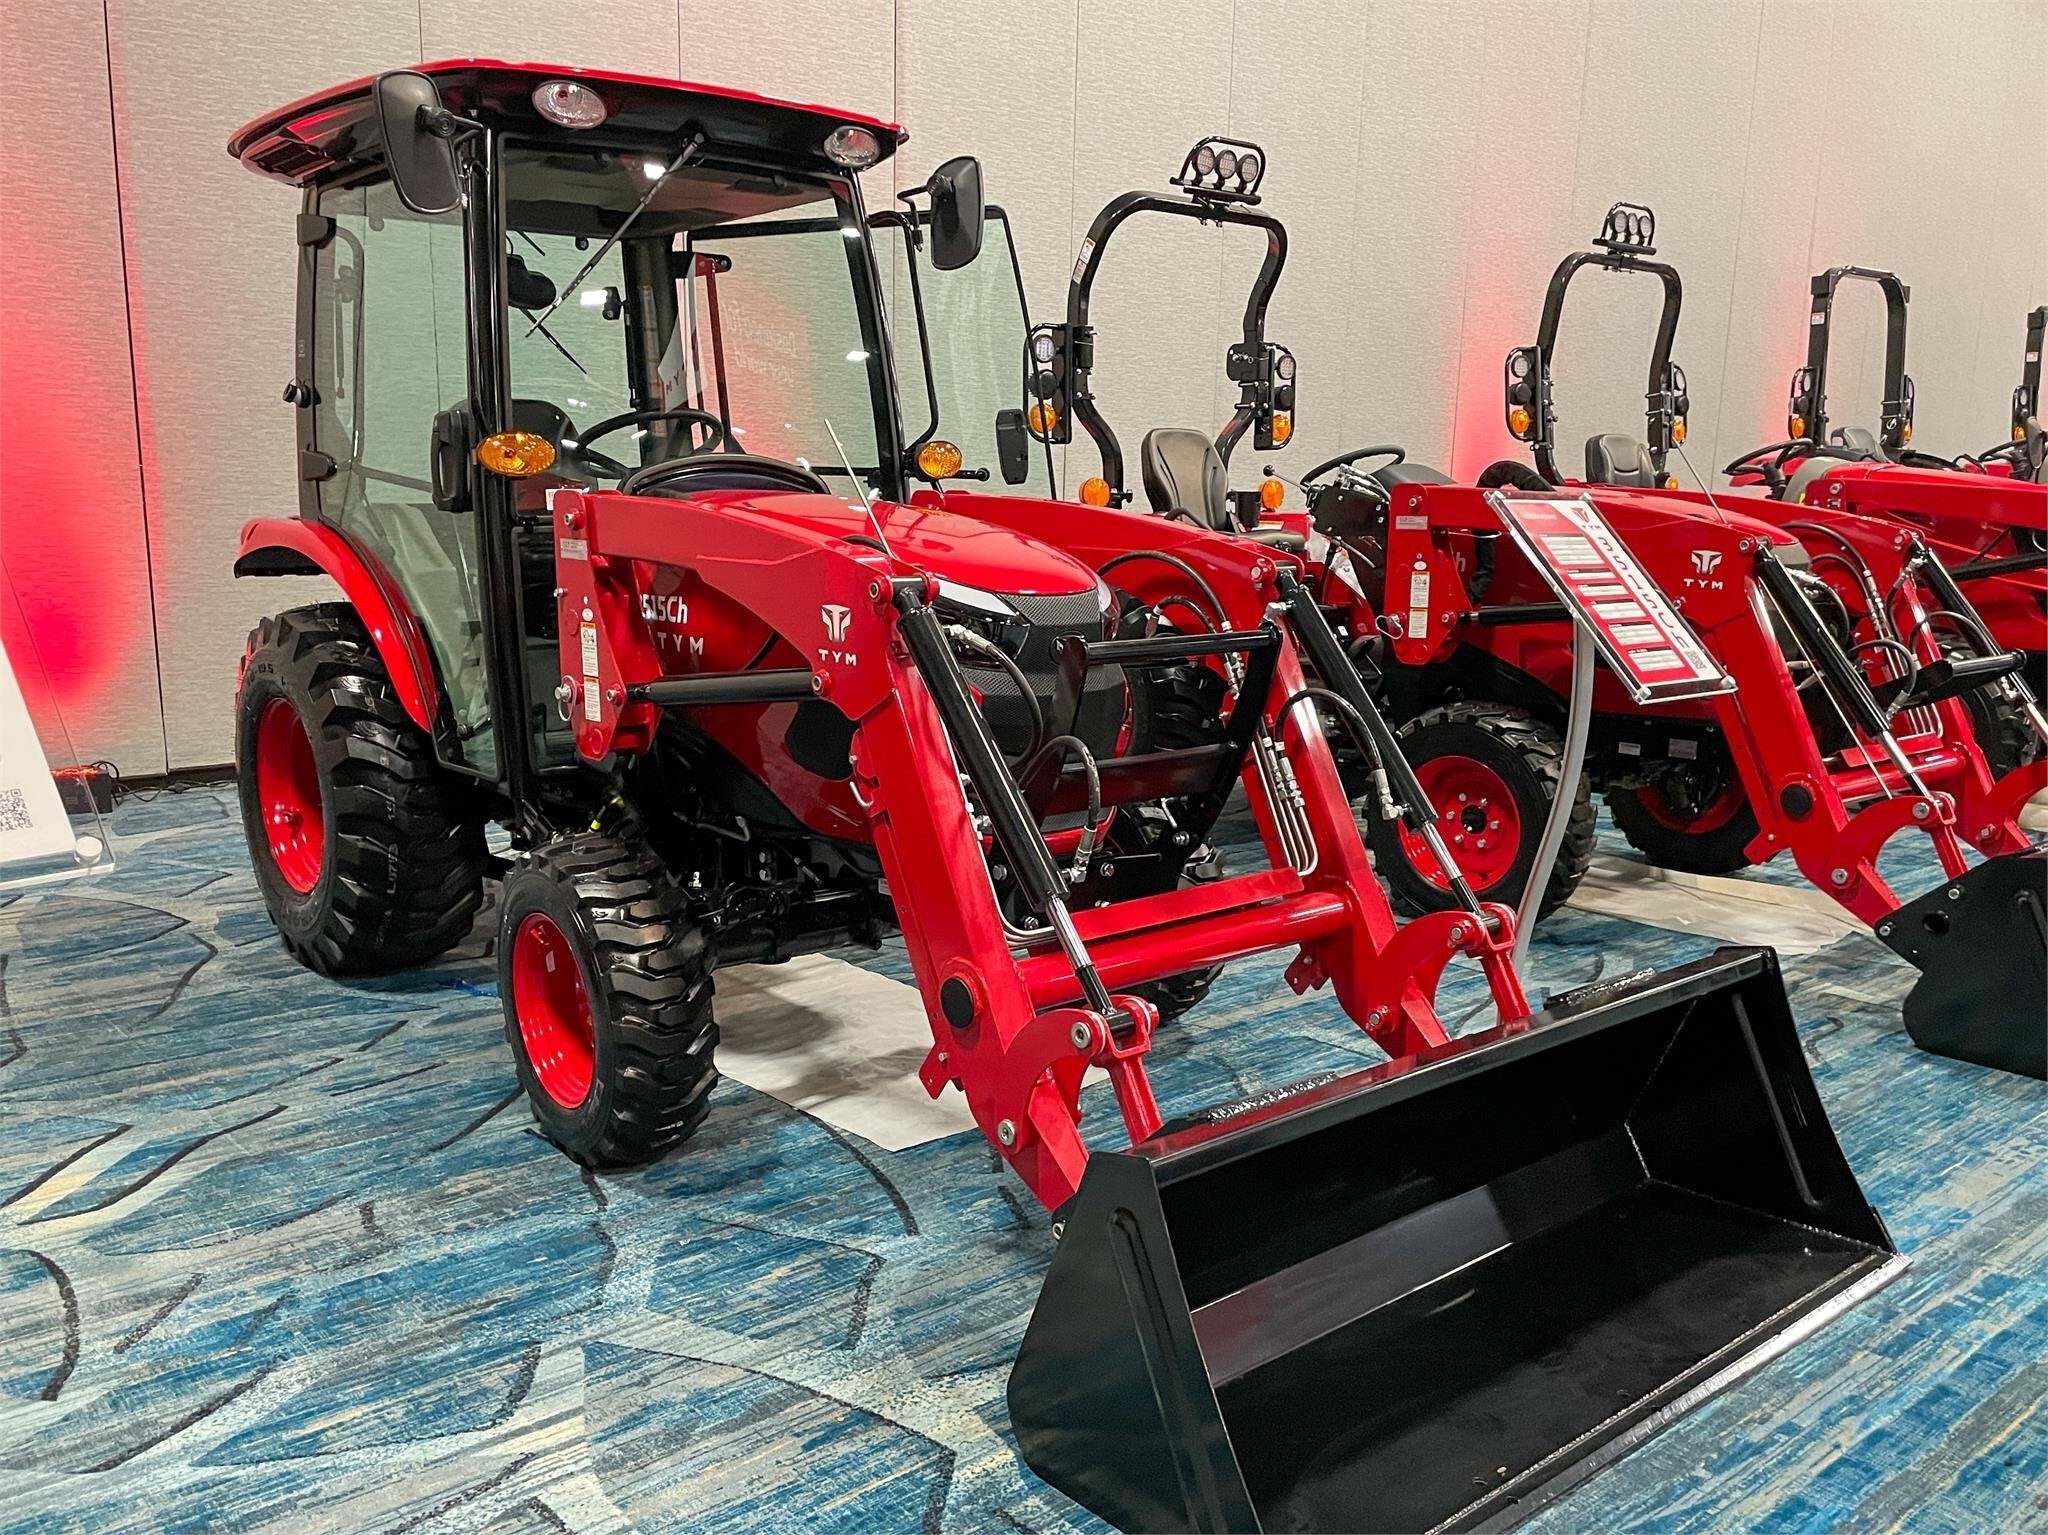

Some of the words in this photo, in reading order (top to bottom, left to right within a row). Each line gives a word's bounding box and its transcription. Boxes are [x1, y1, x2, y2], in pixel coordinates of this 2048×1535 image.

[1683, 578, 1724, 591] TYM
[639, 593, 689, 625] 515Ch
[656, 631, 704, 656] TYM
[818, 648, 858, 667] TYM
